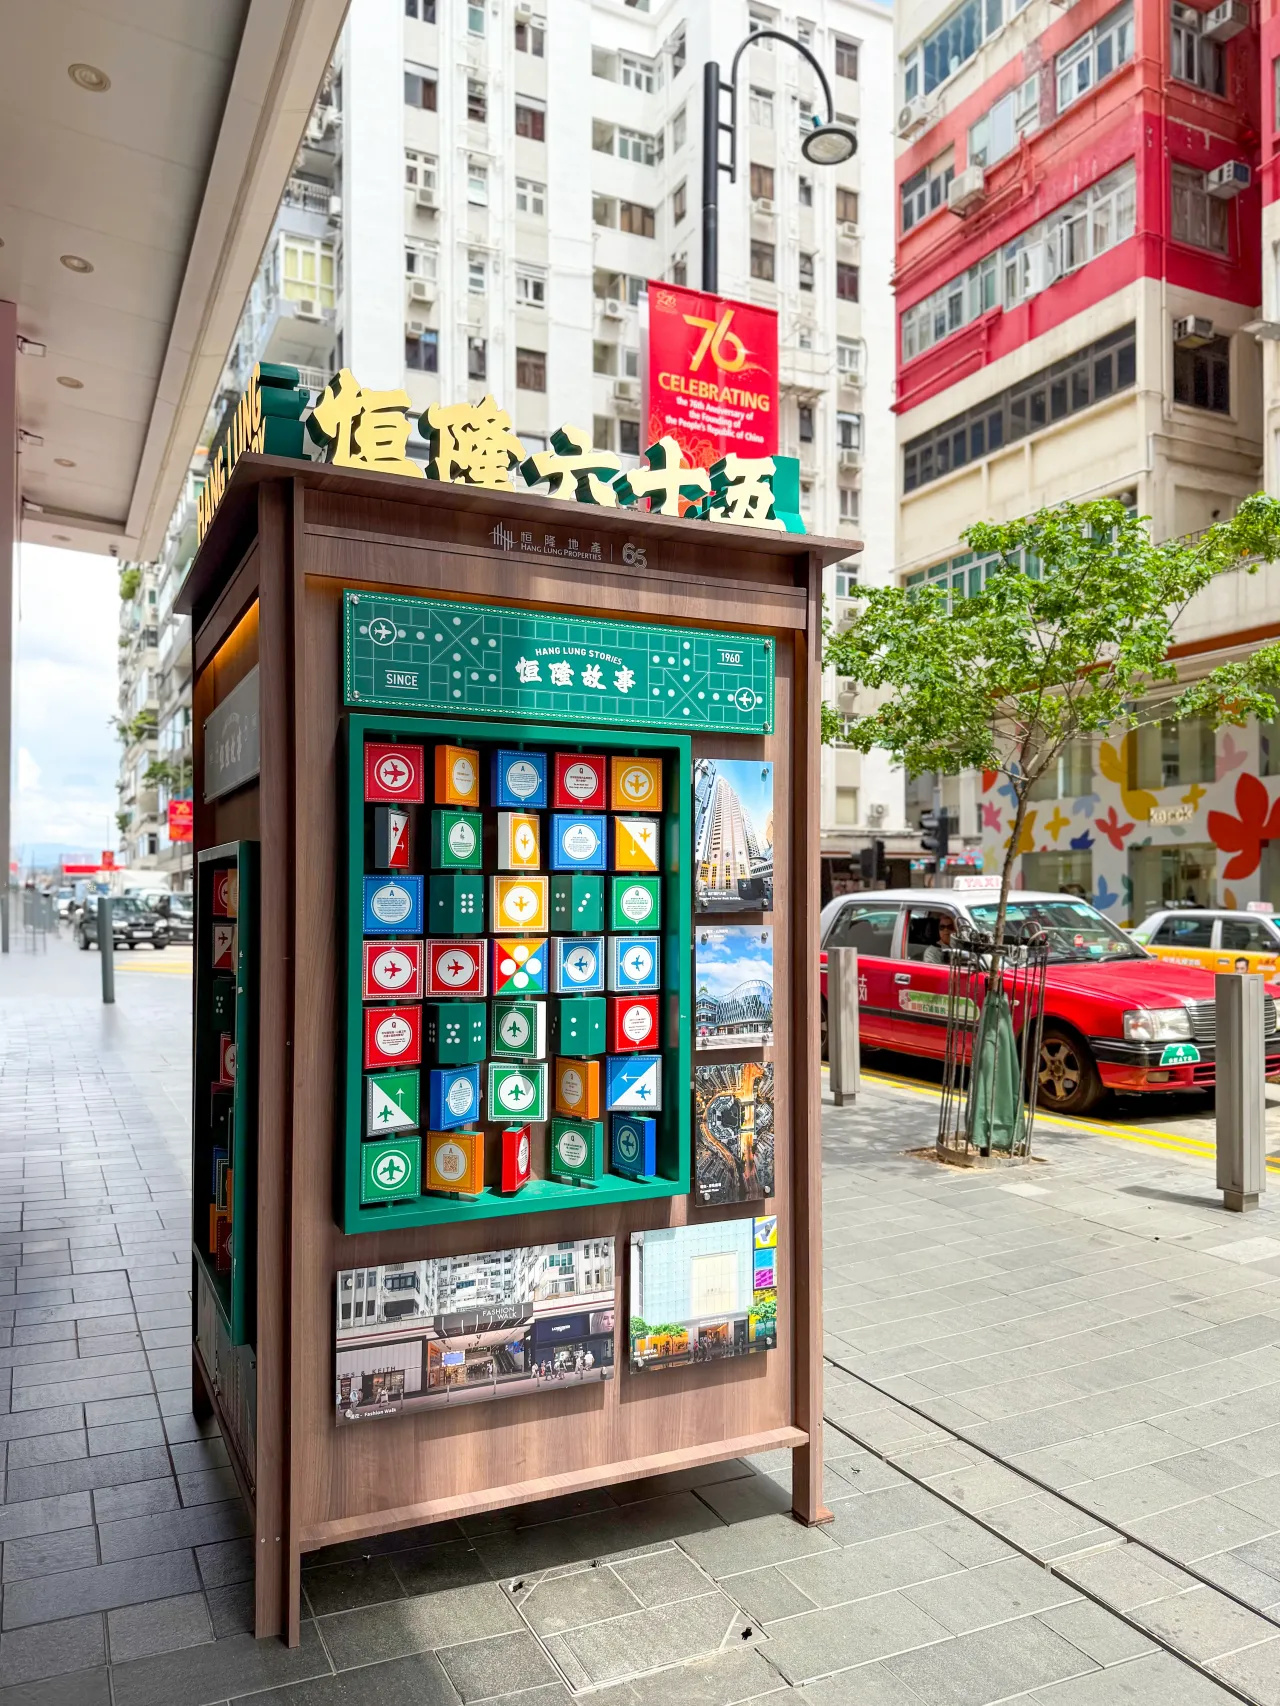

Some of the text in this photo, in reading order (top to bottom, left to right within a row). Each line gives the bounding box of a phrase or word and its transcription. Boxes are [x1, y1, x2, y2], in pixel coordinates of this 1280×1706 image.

[682, 309, 746, 373] 76
[657, 371, 771, 413] CELEBRATING
[676, 396, 689, 407] the
[705, 402, 745, 421] Anniversary
[746, 411, 754, 421] of
[665, 415, 677, 426] the
[678, 417, 706, 432] People's
[707, 424, 735, 438] Republic
[744, 433, 765, 444] China
[701, 413, 733, 429] Founding
[197, 445, 226, 547] HANG
[227, 361, 262, 480] LUNG
[308, 367, 786, 533] 恒隆六十五
[520, 531, 602, 553] 恒隆地產
[520, 543, 602, 561] HANG LUNG PROPERTIES
[535, 647, 623, 666] HANG LUNG STORIES
[721, 652, 741, 664] 1960
[386, 673, 418, 687] SINCE
[515, 656, 636, 694] 恒隆故事
[964, 877, 1000, 888] TAXI
[1168, 1055, 1193, 1064] SEATS
[1176, 1046, 1185, 1057] 4
[482, 1306, 515, 1317] FASHION
[497, 1311, 517, 1320] WALK
[372, 1366, 396, 1375] KEITH
